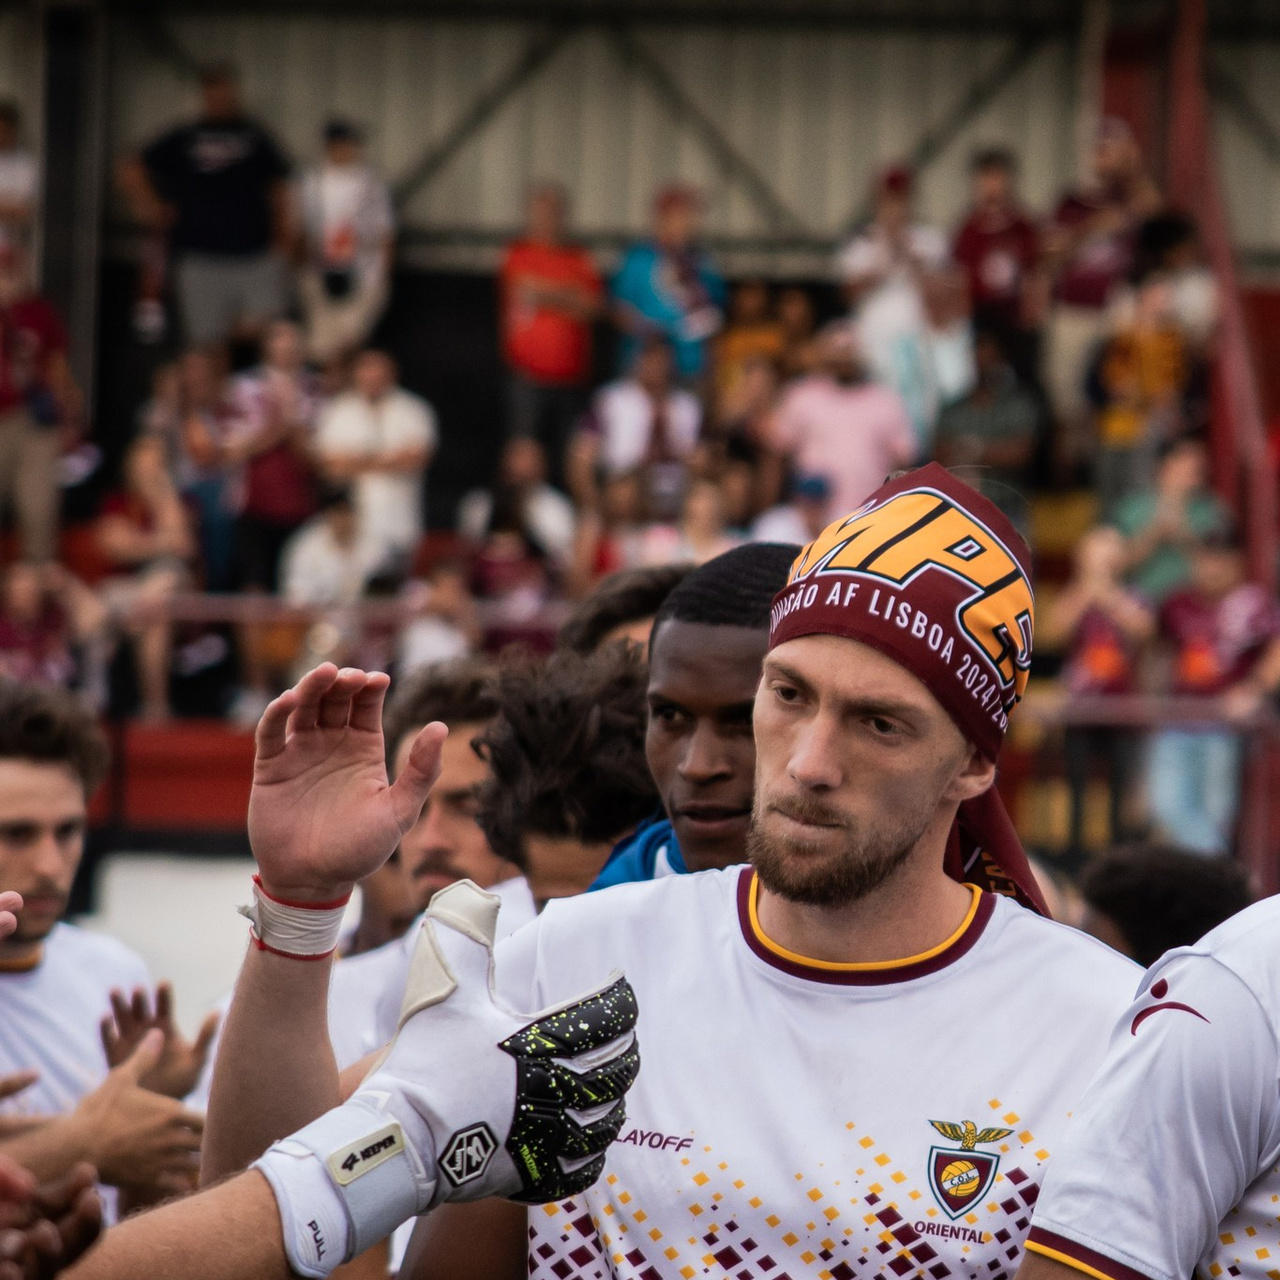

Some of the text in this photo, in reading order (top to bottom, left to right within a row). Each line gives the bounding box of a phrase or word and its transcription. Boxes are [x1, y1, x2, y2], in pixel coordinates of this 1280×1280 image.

[825, 581, 860, 607] AF
[868, 589, 956, 665] LISBOA
[956, 653, 1009, 734] 2024/20
[307, 1220, 326, 1262] PULL
[914, 1220, 986, 1245] ORIENTAL
